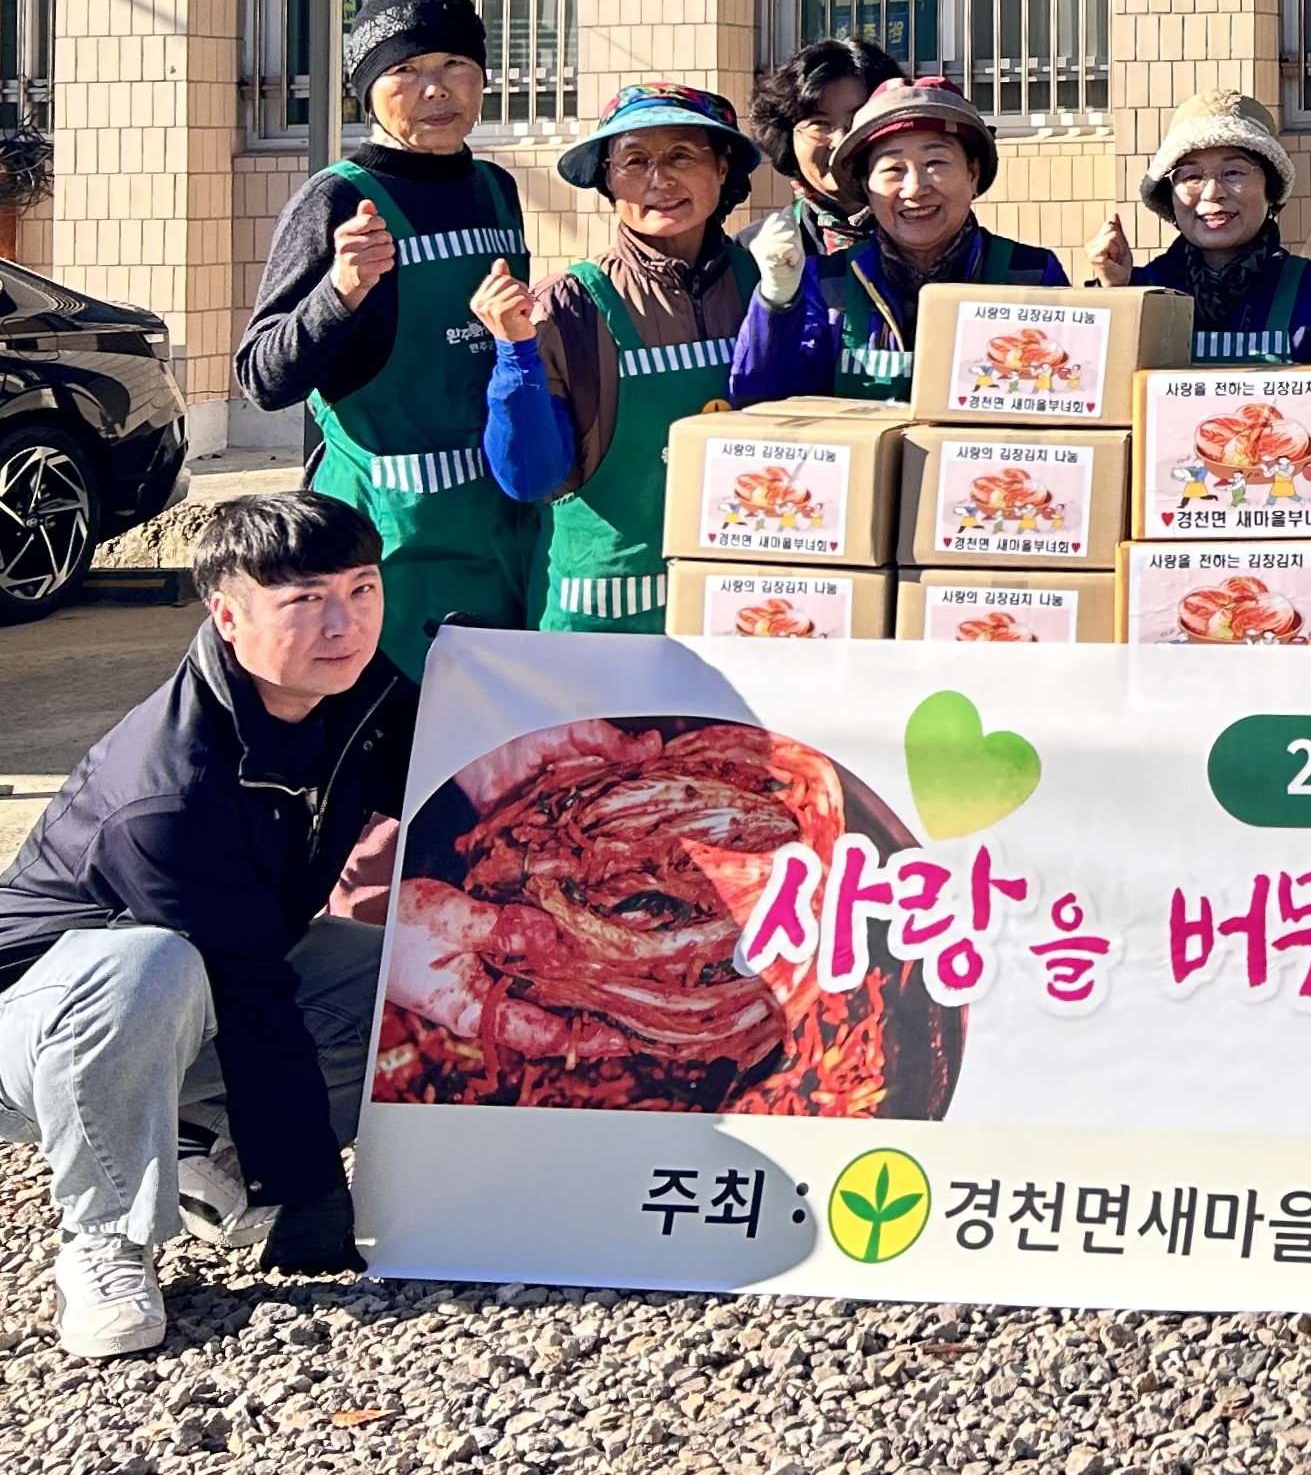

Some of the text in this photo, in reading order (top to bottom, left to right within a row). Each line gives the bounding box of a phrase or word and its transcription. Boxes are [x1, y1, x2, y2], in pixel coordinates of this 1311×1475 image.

[975, 306, 1095, 324] 사랑의 김장김치 나눔
[1167, 383, 1205, 396] 사랑을
[1216, 382, 1253, 395] 전하는
[971, 396, 1081, 413] 경천면 새마을부녀회
[722, 443, 835, 462] 사랑의 김장김치 나눔
[958, 447, 1076, 462] 사랑의 김장김치 나눔
[1178, 510, 1226, 529] 경천면
[720, 534, 827, 551] 경천면 새마을부녀회
[955, 537, 1068, 553] 경천면 새마을부녀회
[1151, 555, 1189, 568] 사랑을
[1200, 555, 1238, 568] 전하는
[1249, 554, 1302, 568] 김장김치
[722, 580, 837, 595] 사랑의 김장김치 나눔
[944, 592, 1061, 606] 사랑의 김장김치 나눔
[746, 844, 1110, 998] 사랑을
